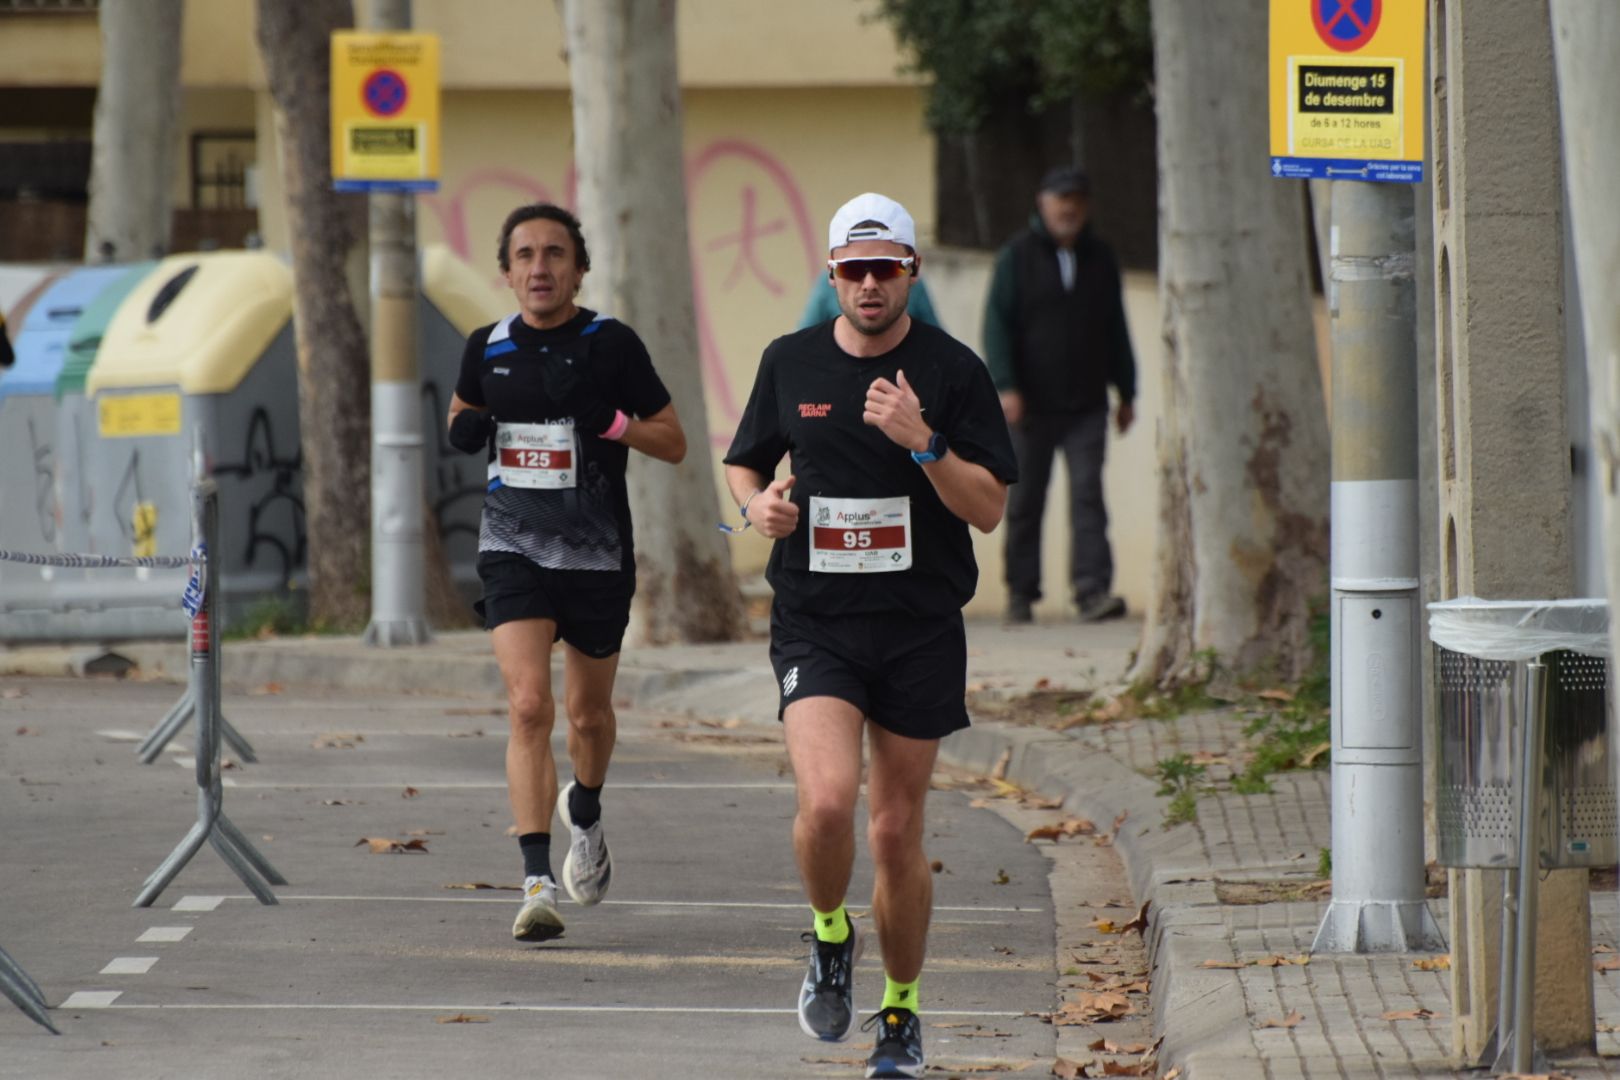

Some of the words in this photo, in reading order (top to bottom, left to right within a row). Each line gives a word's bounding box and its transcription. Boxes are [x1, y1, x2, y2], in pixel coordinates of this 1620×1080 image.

[1305, 72, 1367, 91] Diumenge
[1370, 73, 1386, 88] 15
[1305, 91, 1320, 106] de
[1323, 91, 1385, 107] desembre
[1311, 118, 1321, 128] de
[1341, 118, 1351, 128] 12
[1353, 118, 1381, 129] hores
[798, 403, 832, 411] RECLAIM
[516, 450, 551, 467] 125
[843, 530, 872, 549] 95
